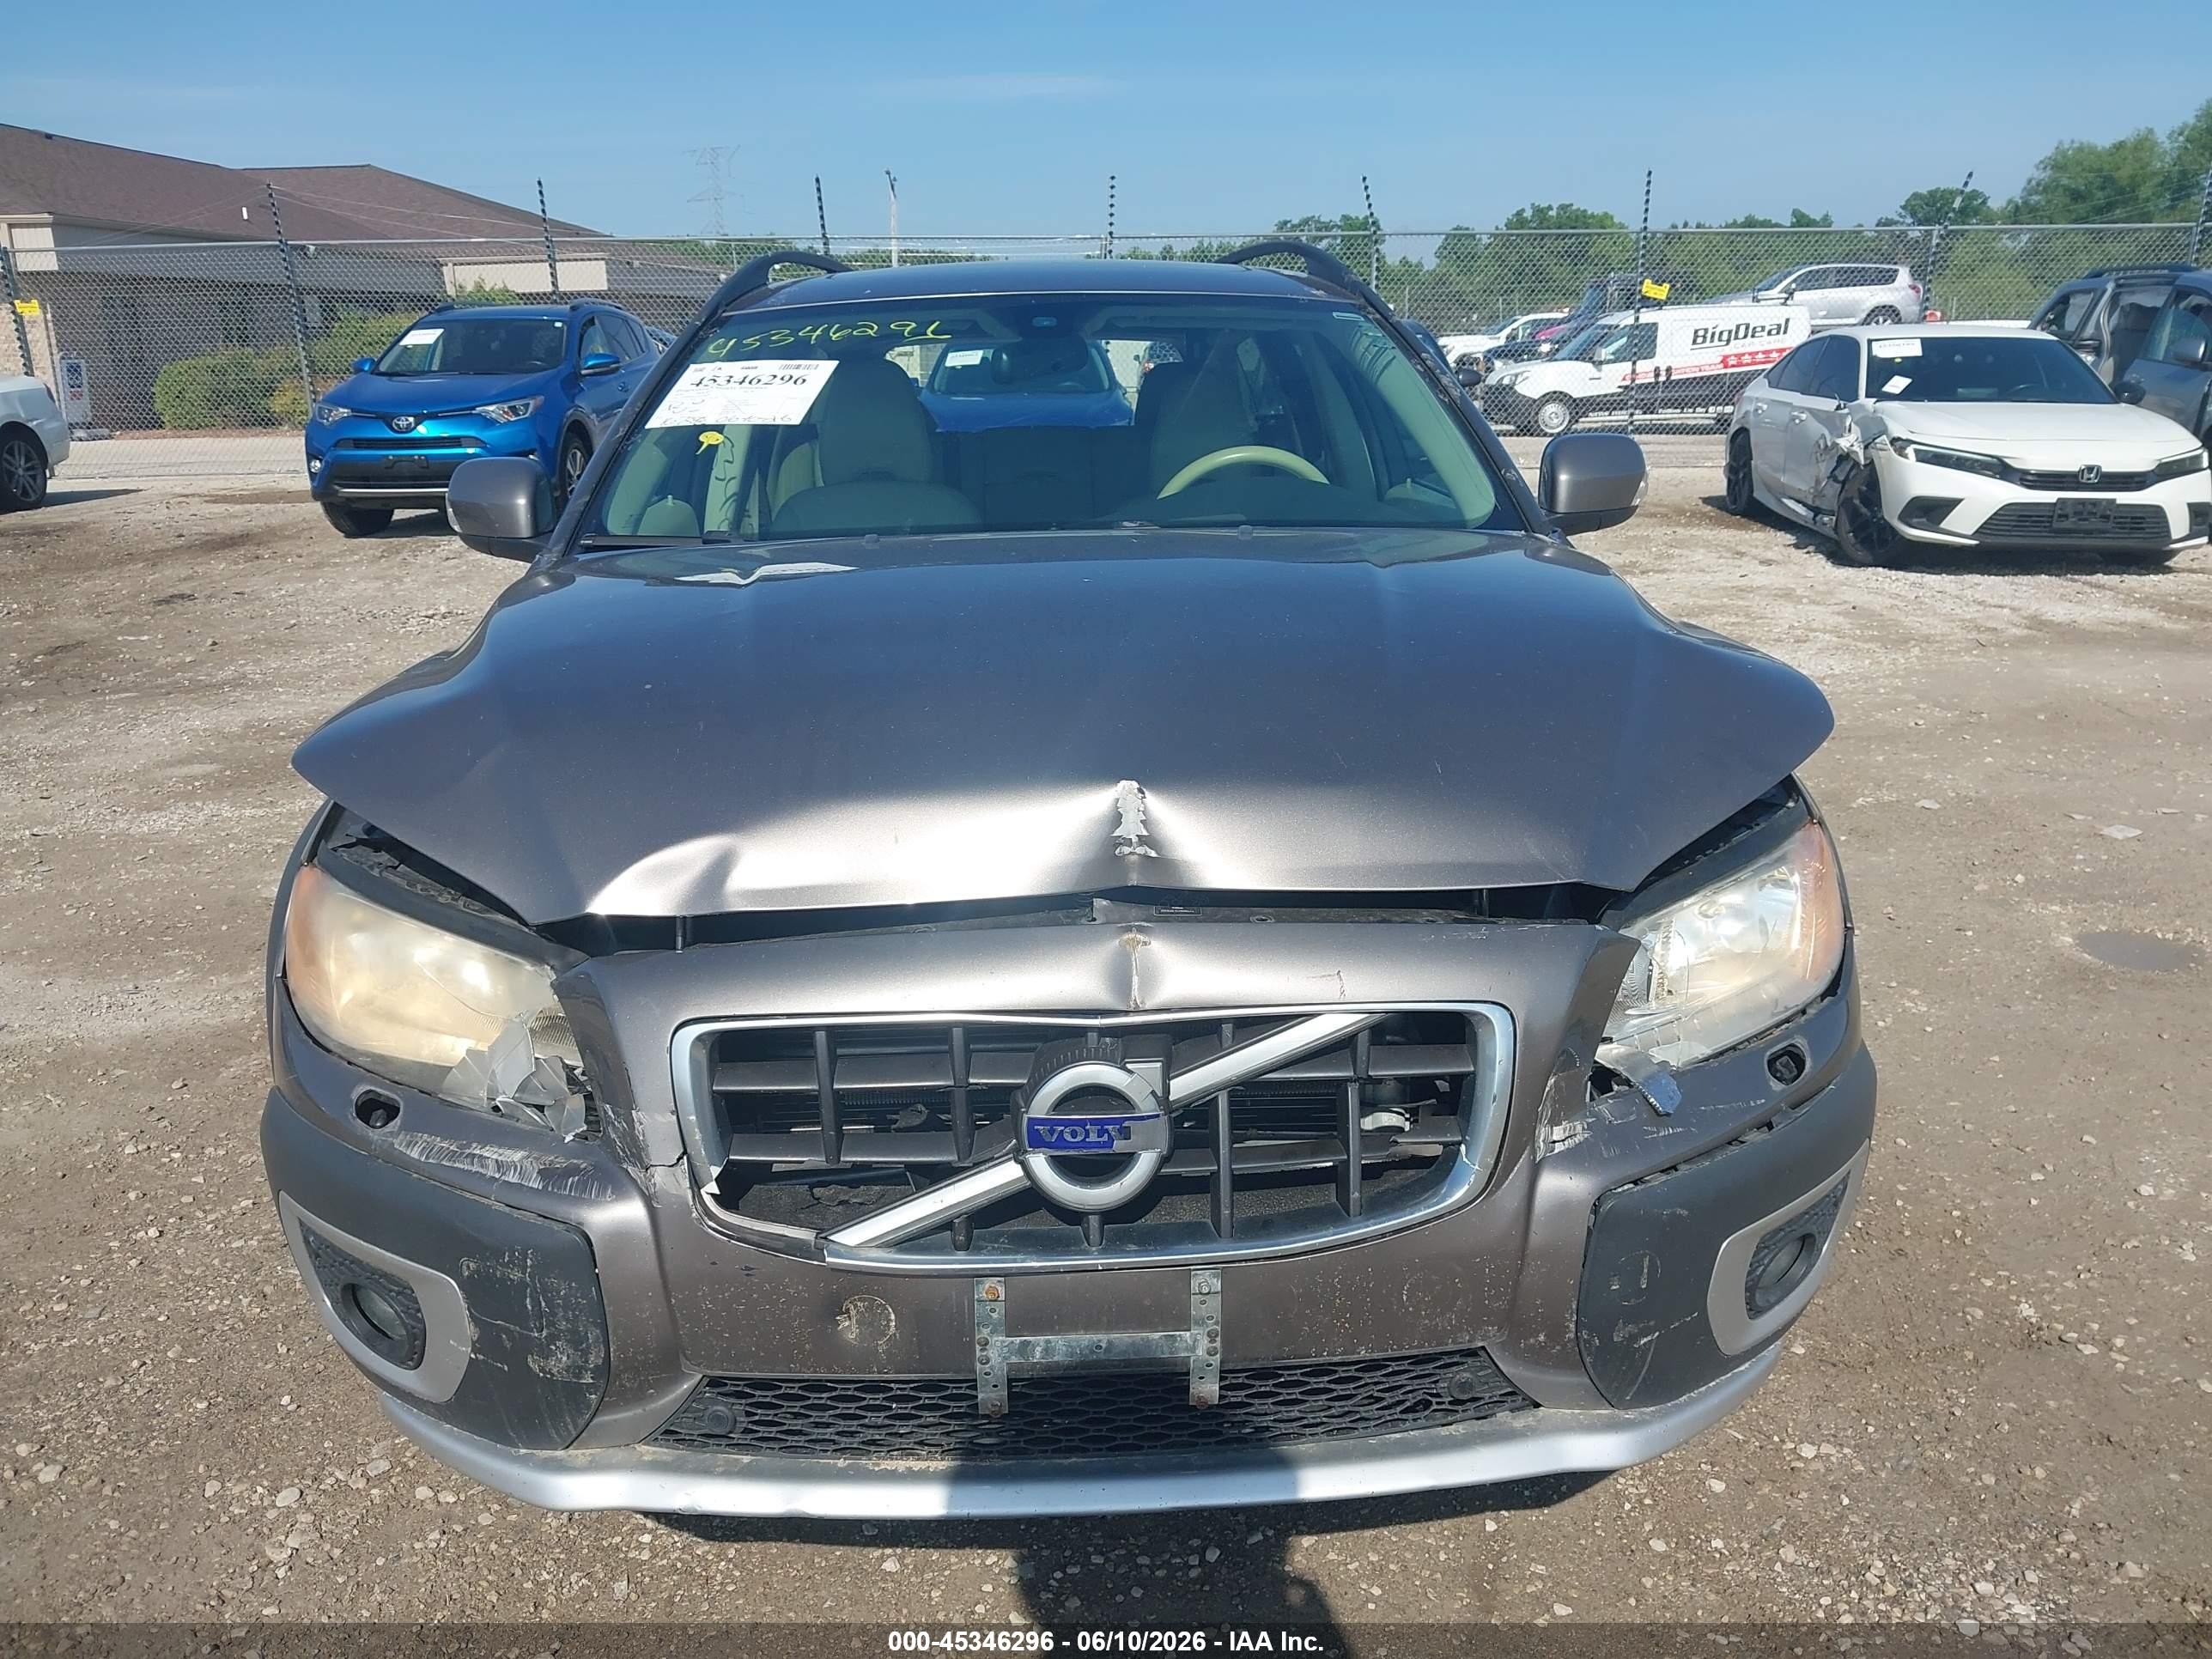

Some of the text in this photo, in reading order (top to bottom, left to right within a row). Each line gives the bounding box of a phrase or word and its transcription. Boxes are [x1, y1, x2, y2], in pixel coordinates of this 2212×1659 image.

[1691, 318, 1790, 347] BigDeal
[690, 373, 811, 387] 45346296
[1035, 1123, 1132, 1142] VOLV
